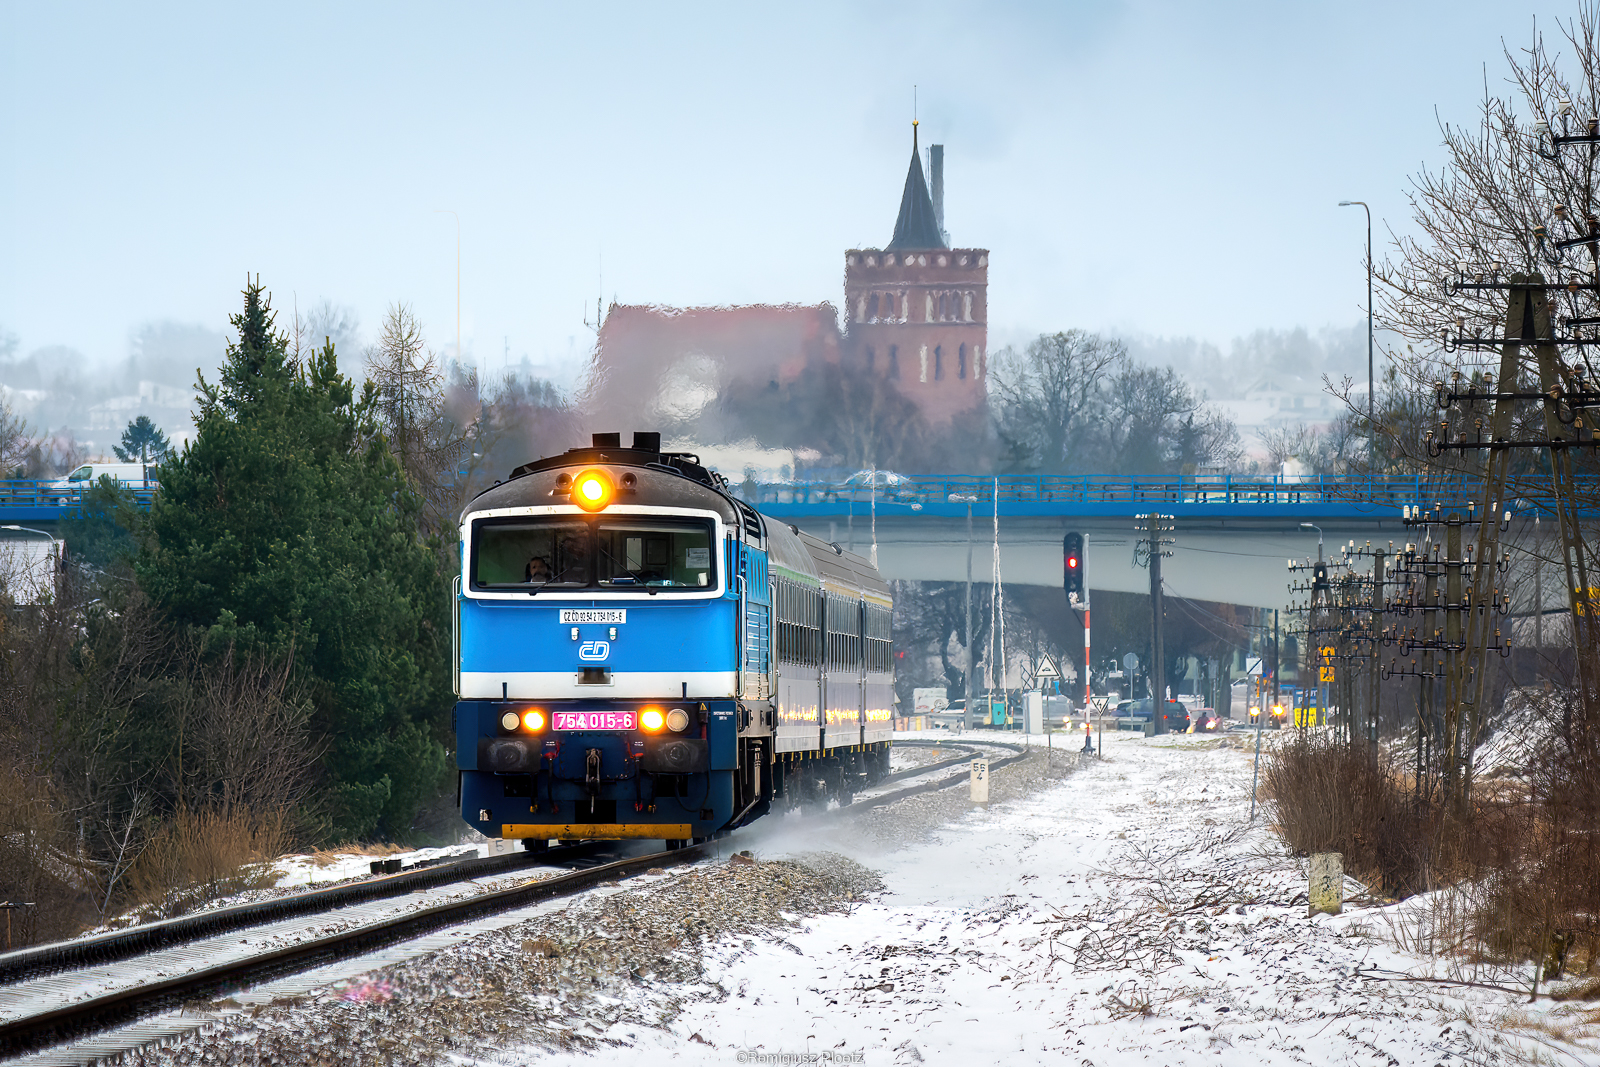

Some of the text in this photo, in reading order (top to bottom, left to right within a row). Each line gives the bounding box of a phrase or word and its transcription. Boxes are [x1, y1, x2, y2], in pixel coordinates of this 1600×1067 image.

[564, 612, 571, 622] CZ
[580, 611, 586, 622] 92
[587, 611, 593, 622] 54
[597, 611, 606, 622] 754
[557, 713, 632, 729] 754 015-6
[976, 772, 982, 780] 4
